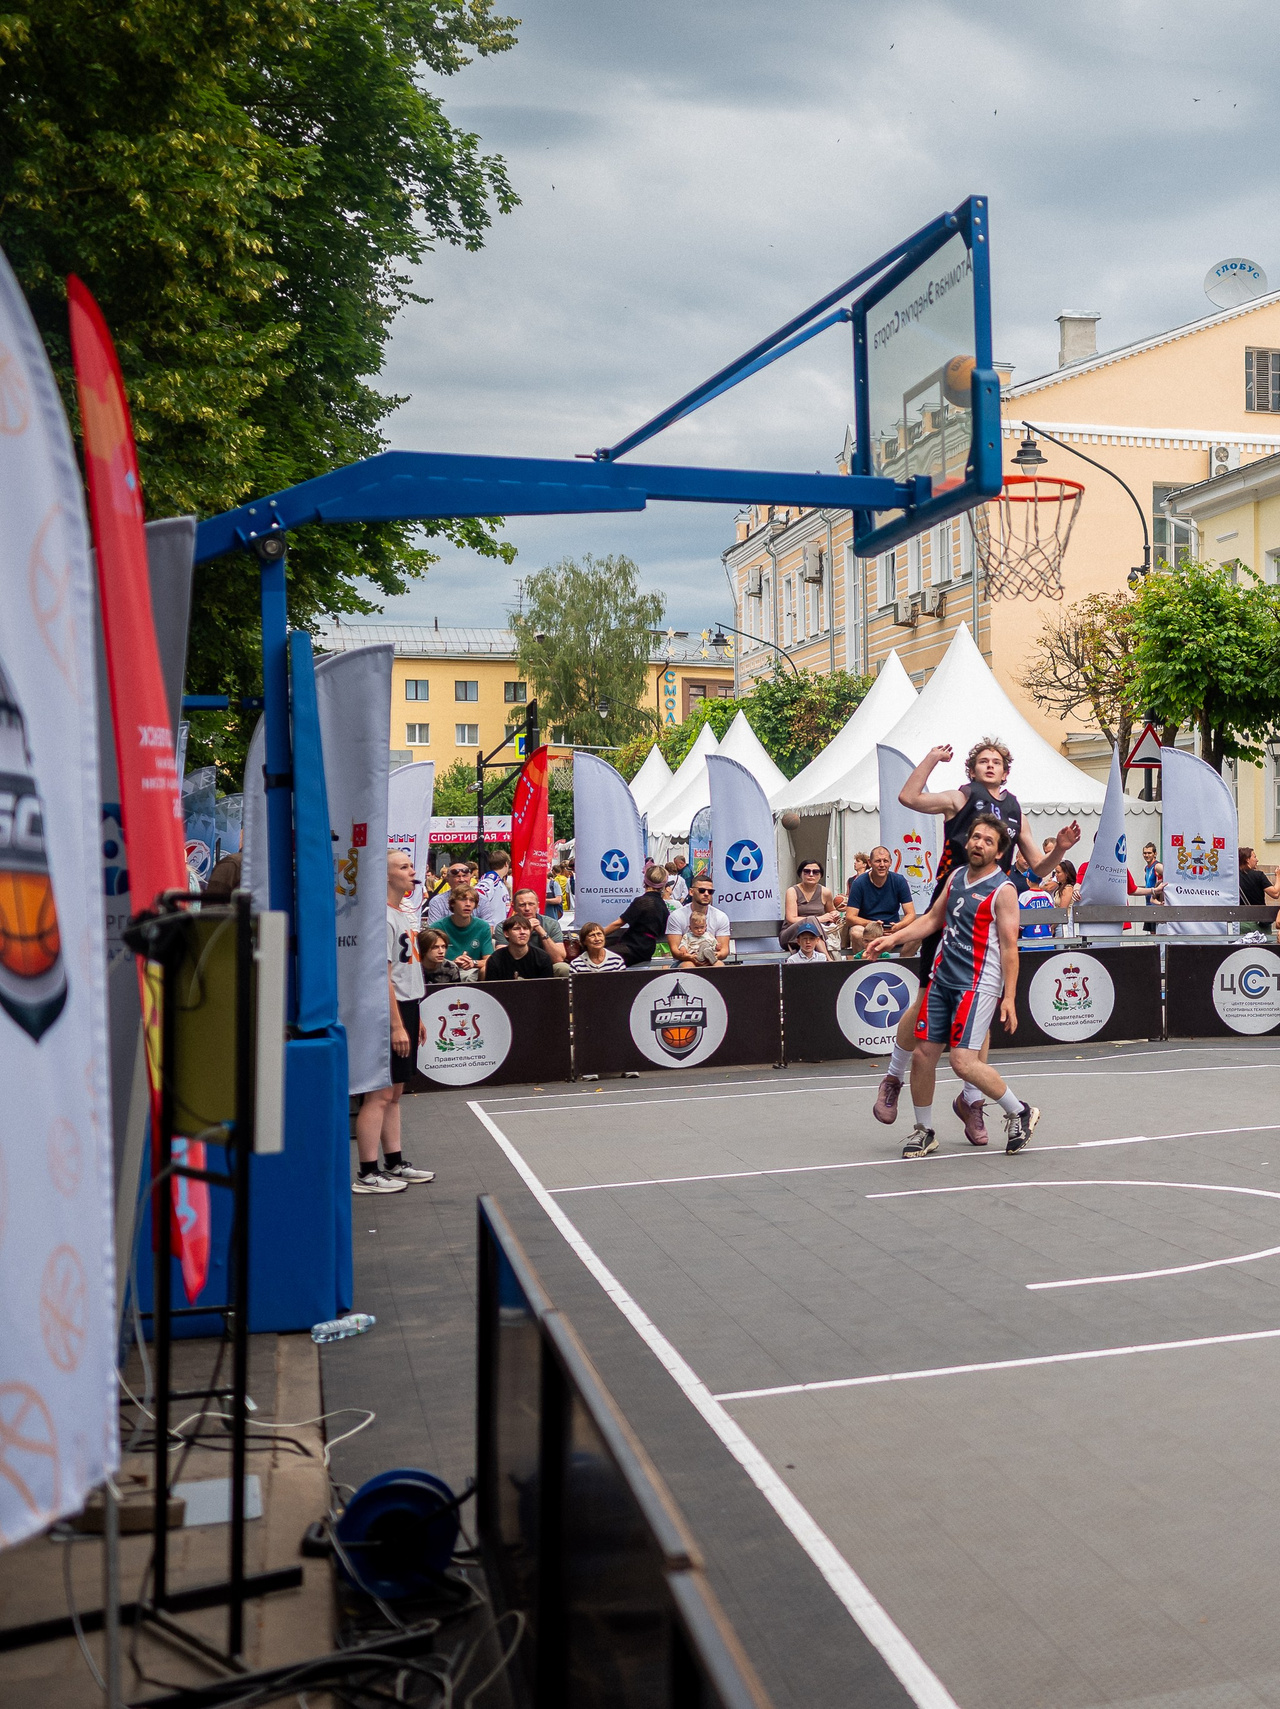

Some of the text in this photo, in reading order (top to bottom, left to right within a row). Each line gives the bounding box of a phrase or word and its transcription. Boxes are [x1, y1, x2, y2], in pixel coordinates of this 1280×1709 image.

[430, 833, 497, 841] СПОРТИВАЯ
[717, 889, 773, 904] РОСАТОМ
[952, 897, 965, 917] 2
[654, 1010, 704, 1025] ФБСО
[1051, 1013, 1094, 1021] Правительство
[1043, 1020, 1079, 1028] Смоленской
[953, 1022, 964, 1042] 2
[434, 1054, 486, 1063] Правительство
[424, 1062, 467, 1070] Смоленской
